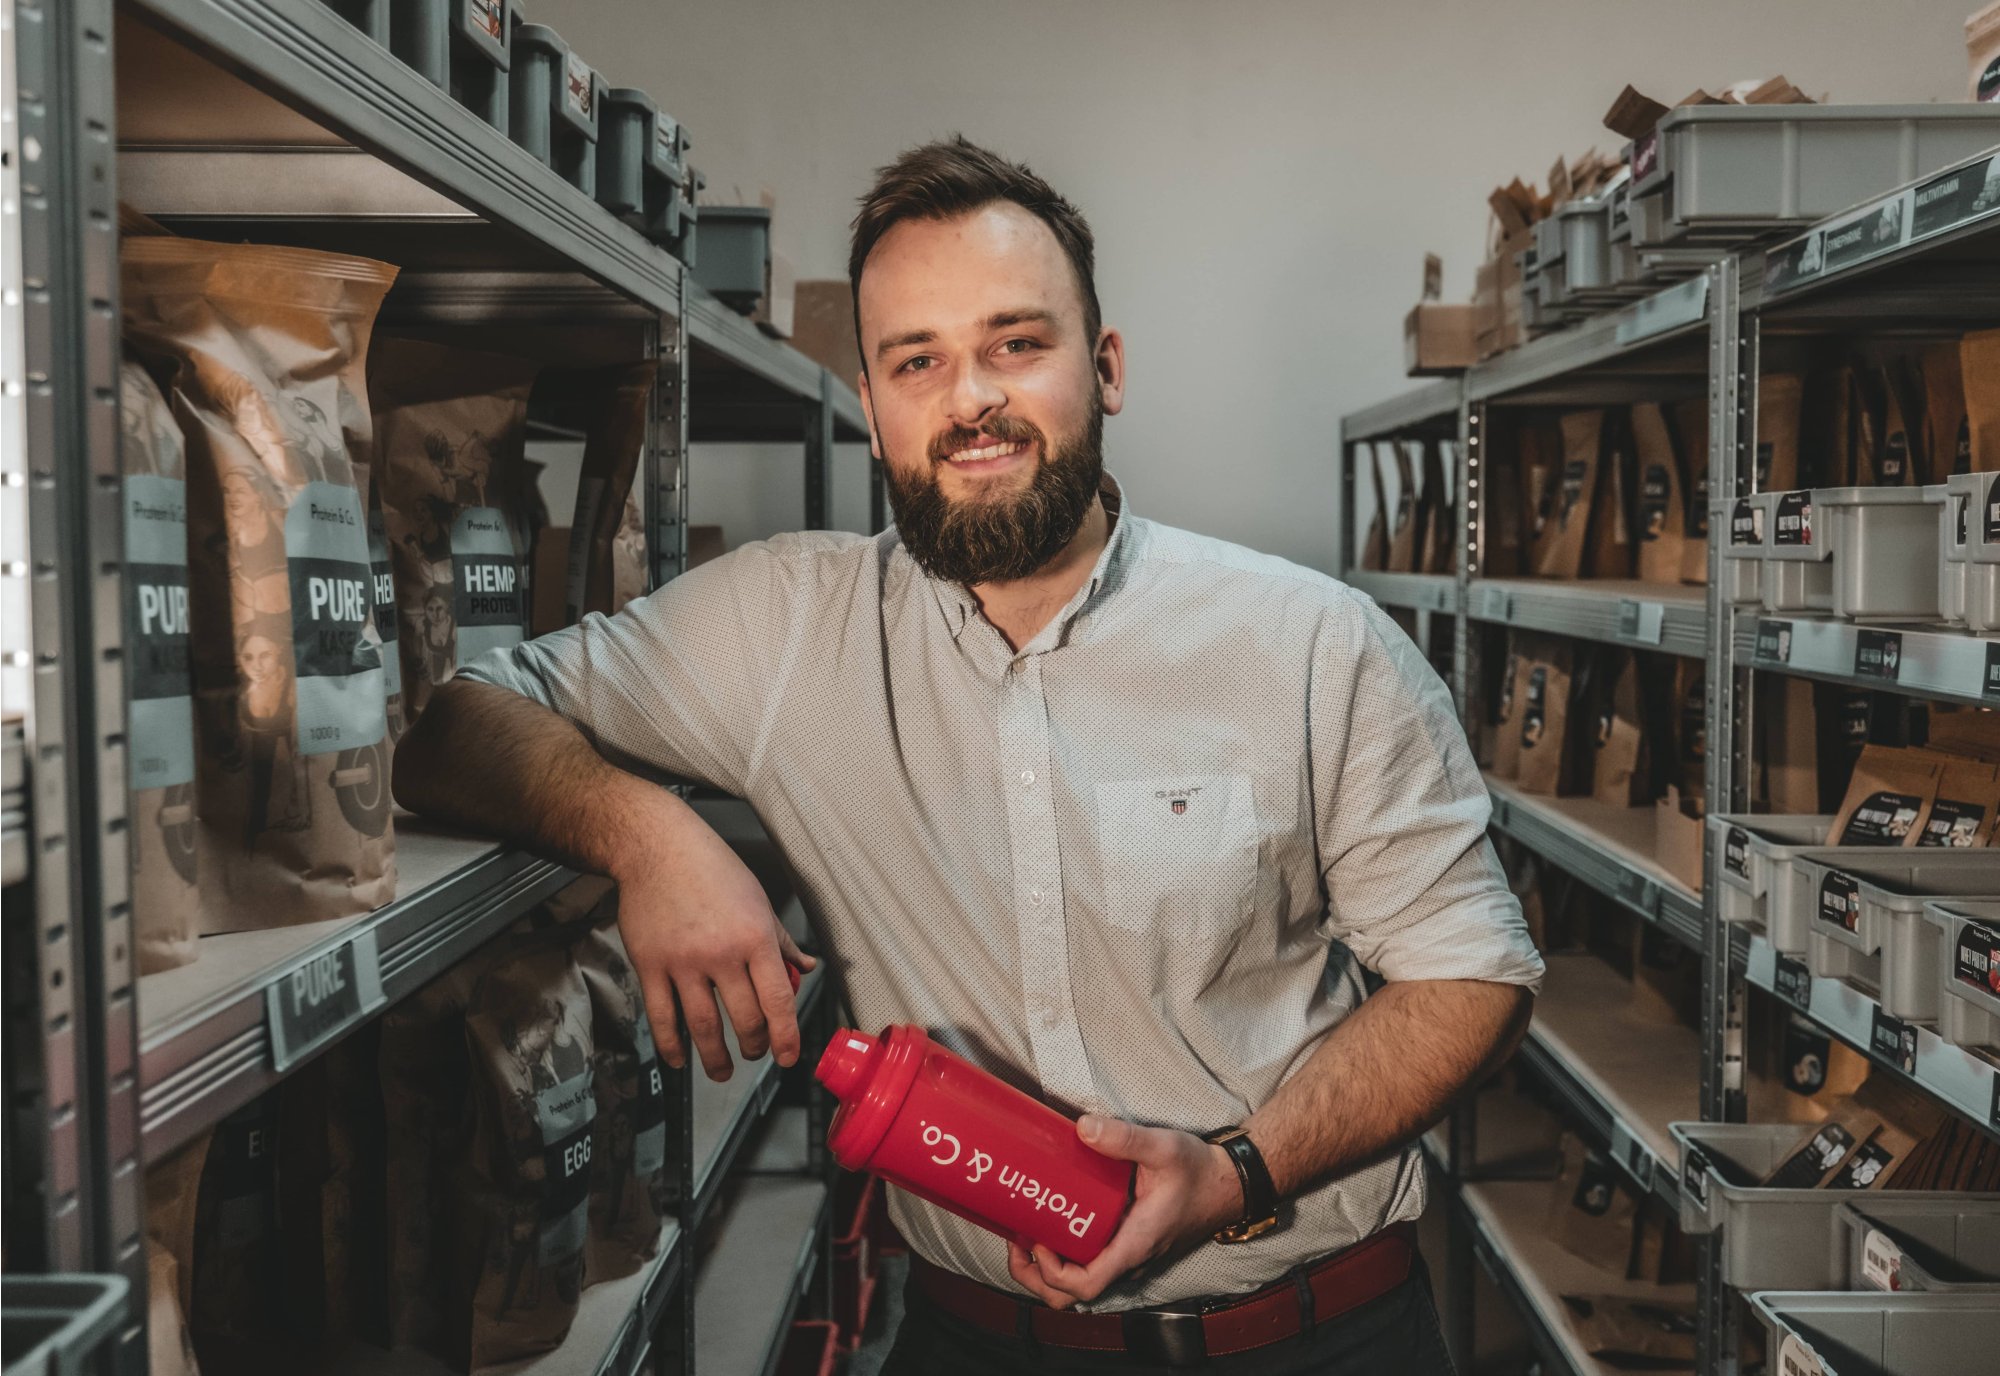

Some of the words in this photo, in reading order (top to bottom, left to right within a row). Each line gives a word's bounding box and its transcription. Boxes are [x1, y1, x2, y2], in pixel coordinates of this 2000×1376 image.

[1915, 178, 1959, 206] MULTIVITAMIN
[310, 503, 337, 522] Protein
[467, 519, 492, 532] Protein
[464, 564, 515, 593] HEMP
[308, 576, 365, 622] PURE
[1155, 786, 1203, 799] GANT
[292, 950, 345, 1016] PURE
[549, 1098, 575, 1116] Protein
[564, 1134, 592, 1178] EGG
[920, 1120, 961, 1165] Co.
[966, 1148, 993, 1183] &
[998, 1165, 1096, 1239] Protein
